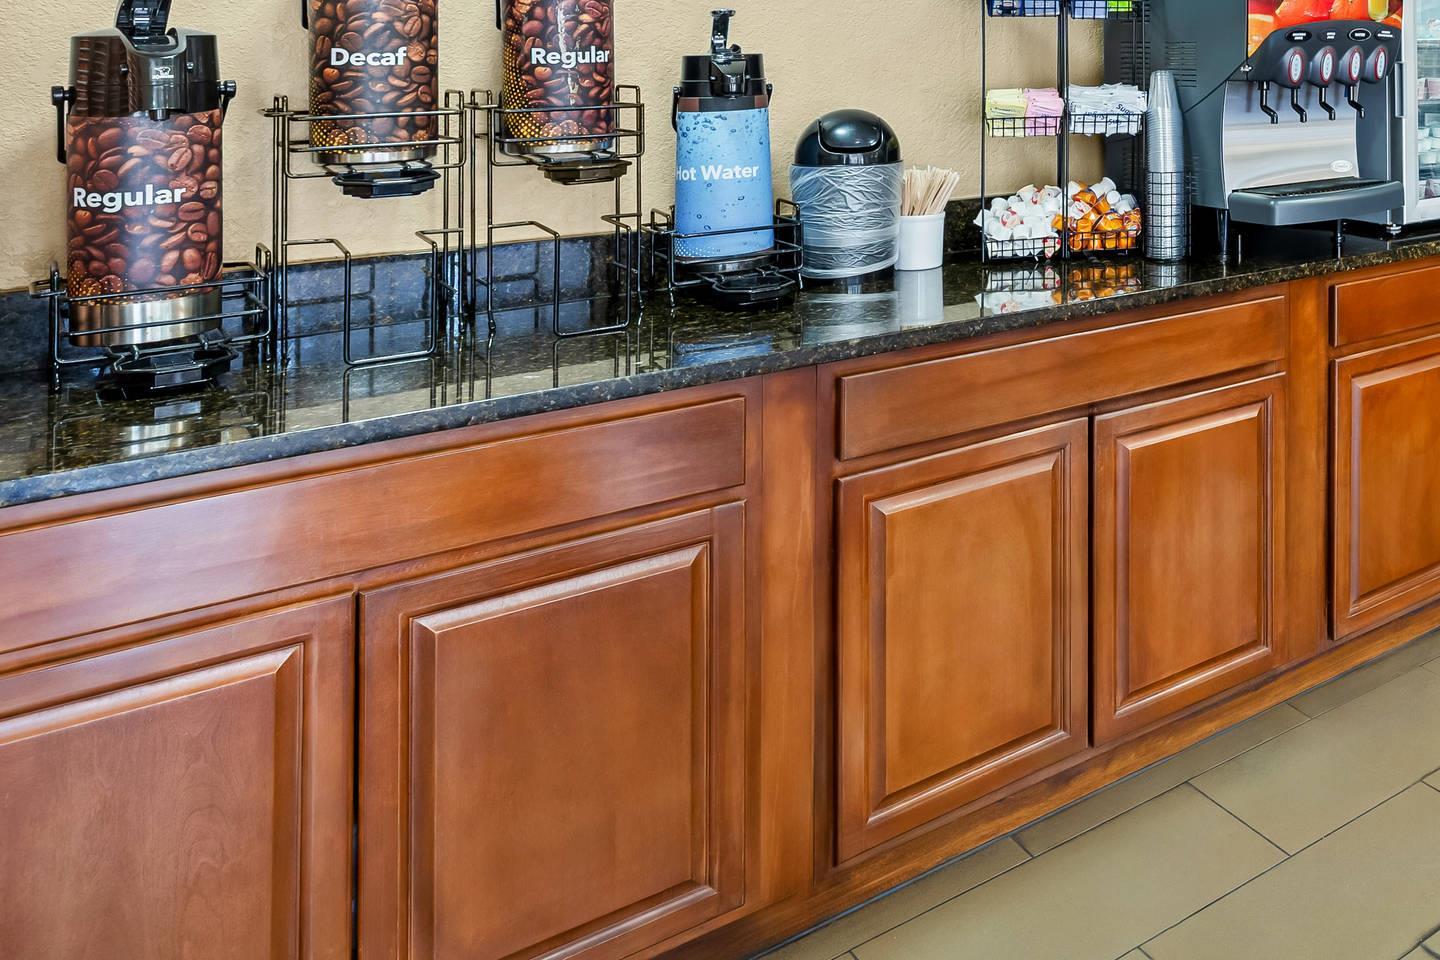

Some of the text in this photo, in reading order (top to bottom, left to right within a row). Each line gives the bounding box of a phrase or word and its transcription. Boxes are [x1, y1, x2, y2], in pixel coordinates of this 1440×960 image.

[330, 47, 407, 66] Decaf
[531, 45, 610, 69] Regular
[701, 164, 760, 181] Water
[73, 184, 187, 213] Regular
